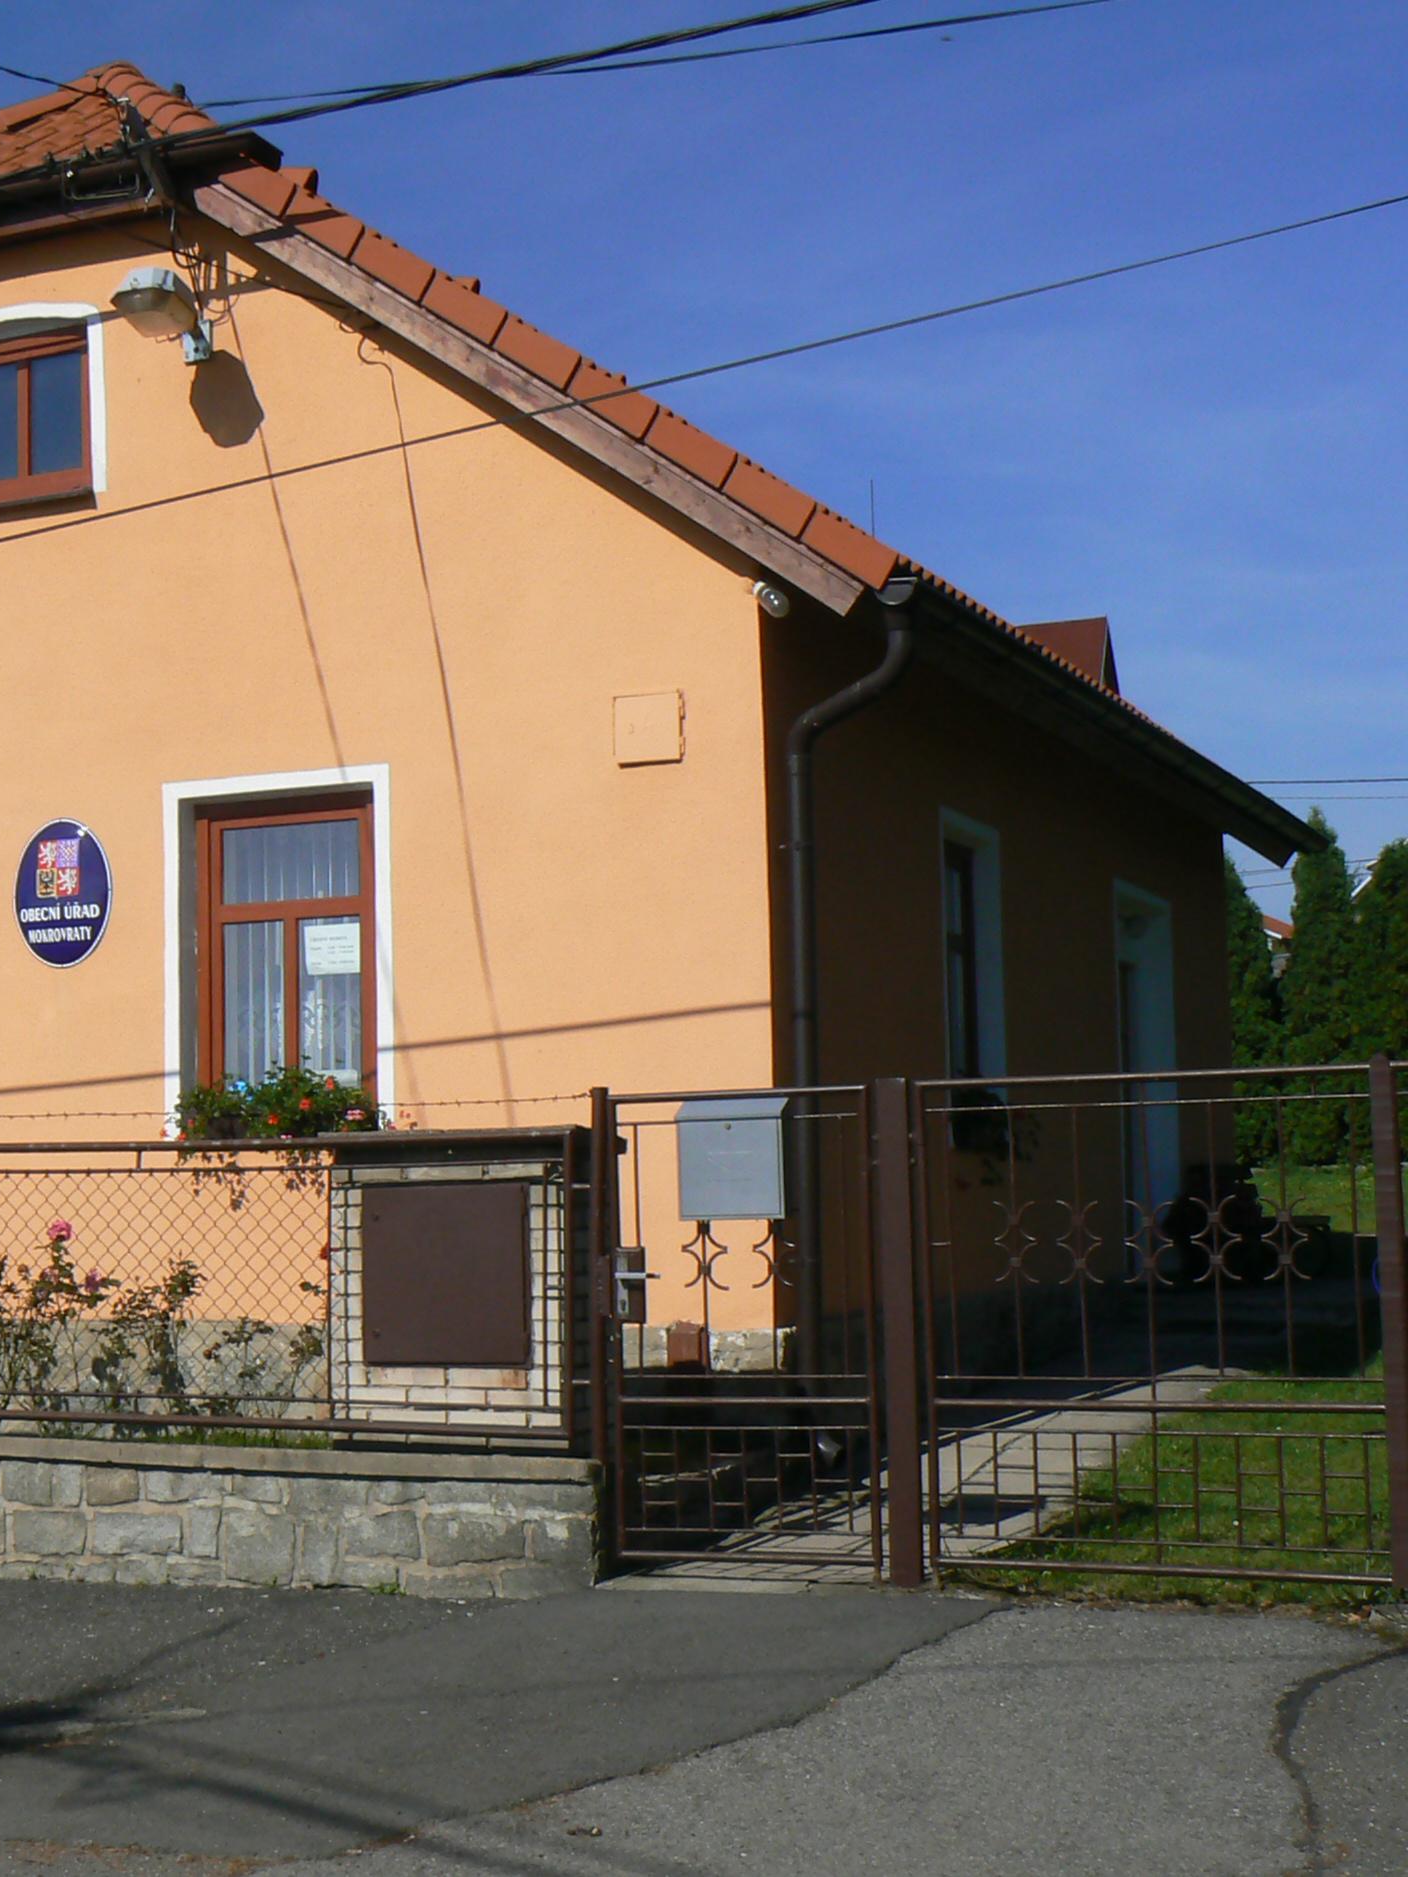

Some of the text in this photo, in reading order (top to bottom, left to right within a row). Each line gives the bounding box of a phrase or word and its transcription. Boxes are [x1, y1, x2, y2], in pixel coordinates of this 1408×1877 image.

[20, 901, 100, 923] OBECNÍ ÚŘAD
[28, 926, 92, 944] MOKROVRATY
